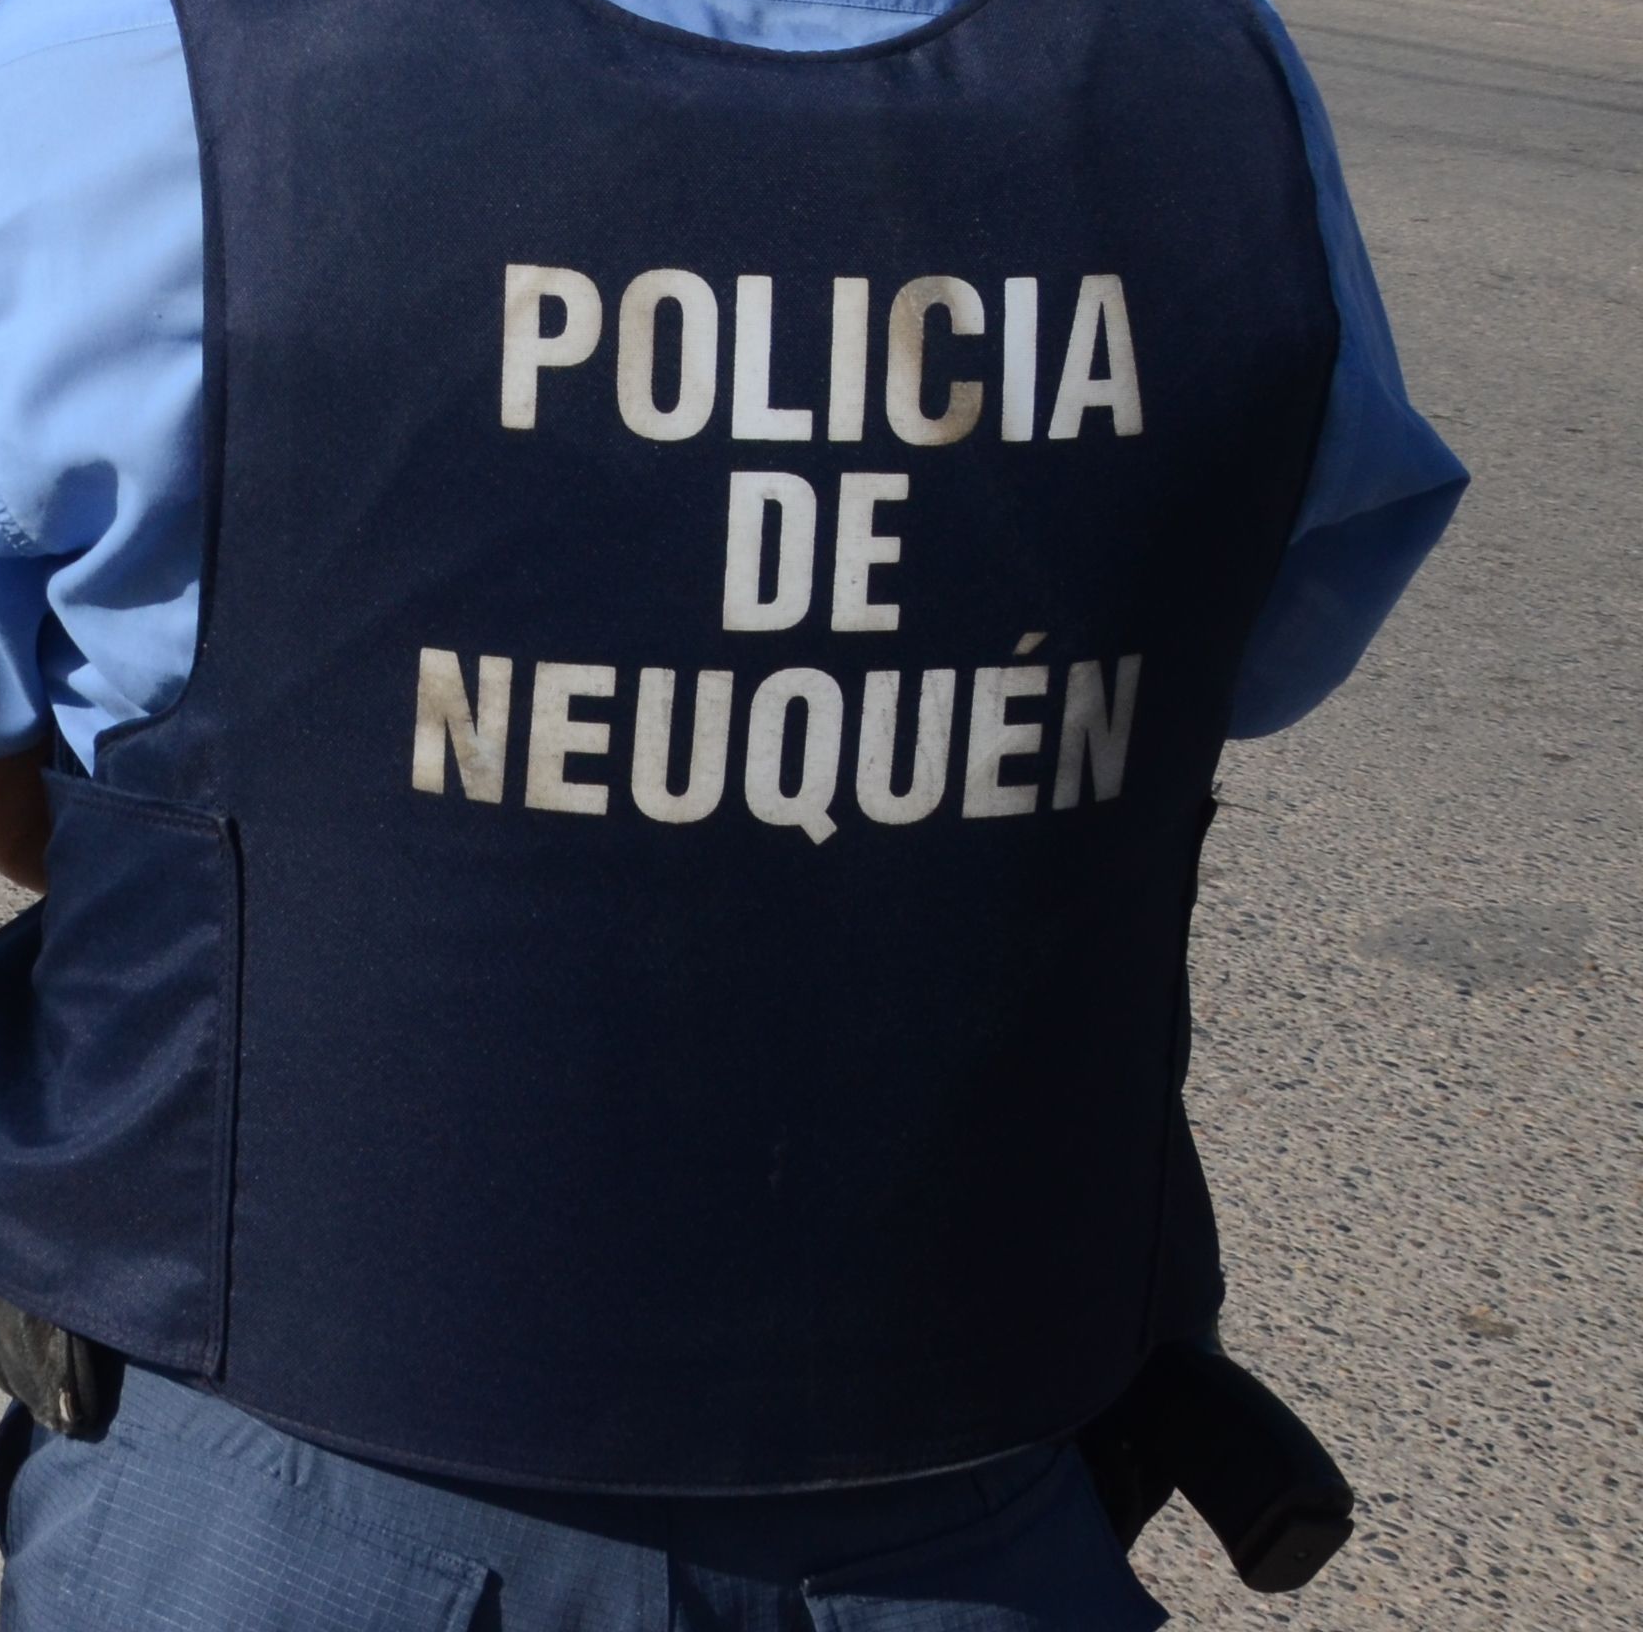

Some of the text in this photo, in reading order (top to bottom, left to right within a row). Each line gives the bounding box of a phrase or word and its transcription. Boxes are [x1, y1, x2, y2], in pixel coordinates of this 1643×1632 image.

[500, 263, 1143, 446] POLICIA
[722, 471, 909, 632] DE
[411, 632, 1143, 846] NEUQUÉN
